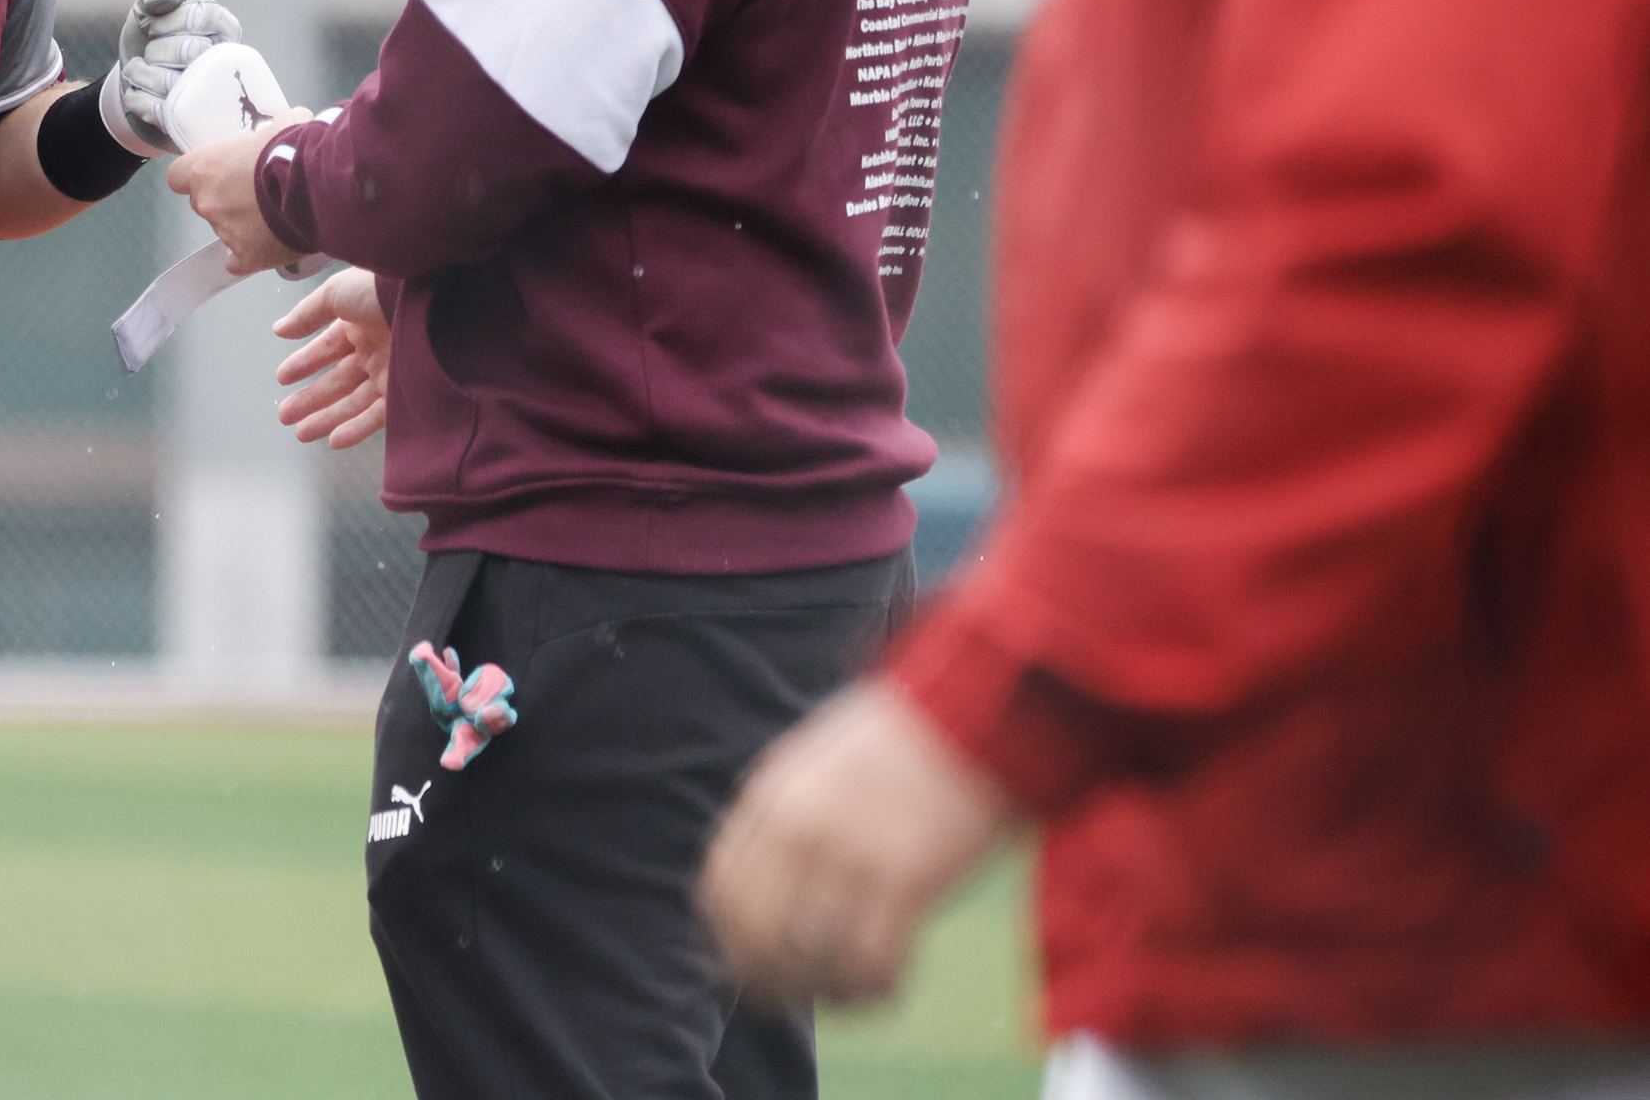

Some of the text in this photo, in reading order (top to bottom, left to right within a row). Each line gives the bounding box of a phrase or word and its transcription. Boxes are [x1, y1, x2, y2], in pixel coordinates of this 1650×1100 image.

[860, 16, 901, 33] Coastal
[845, 42, 894, 60] Northrim
[857, 65, 891, 82] NAPA
[850, 89, 890, 106] Marble
[368, 807, 411, 843] PUMA
